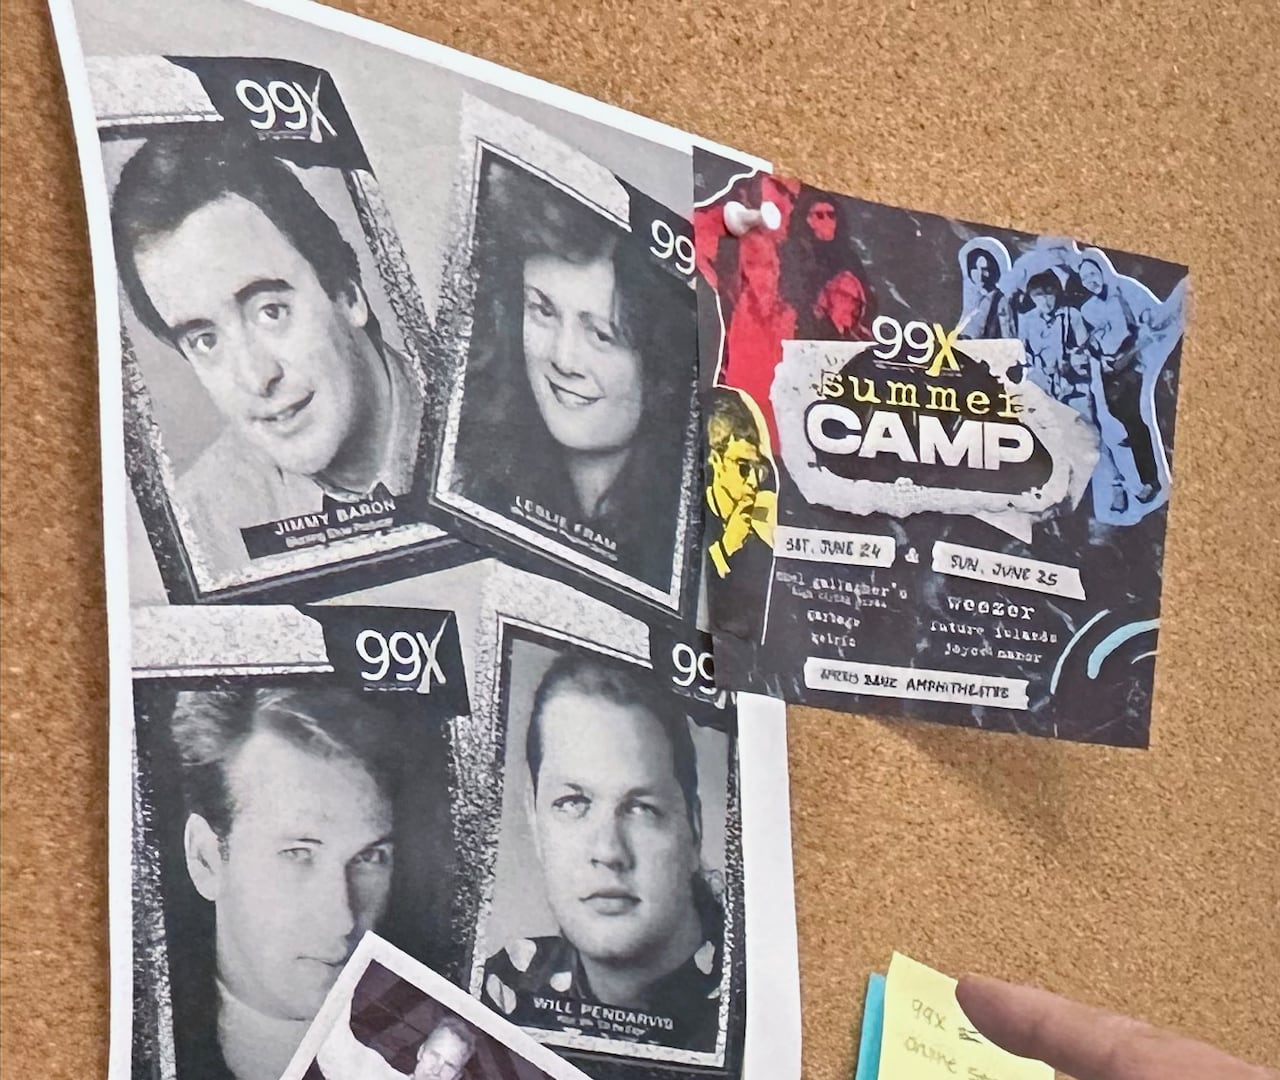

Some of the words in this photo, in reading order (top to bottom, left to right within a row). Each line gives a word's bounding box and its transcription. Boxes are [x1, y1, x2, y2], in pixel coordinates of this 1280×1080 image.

[235, 74, 338, 143] 99X
[650, 219, 697, 290] 99
[872, 304, 982, 377] 99X
[820, 367, 1037, 420] summer
[806, 404, 1035, 471] CAMP
[274, 512, 330, 536] JIMMY
[335, 499, 397, 523] BARON
[820, 539, 855, 557] JUNE
[859, 542, 882, 560] 24
[991, 562, 1031, 582] JUNE
[1035, 569, 1059, 587] 25
[354, 611, 452, 694] 99X
